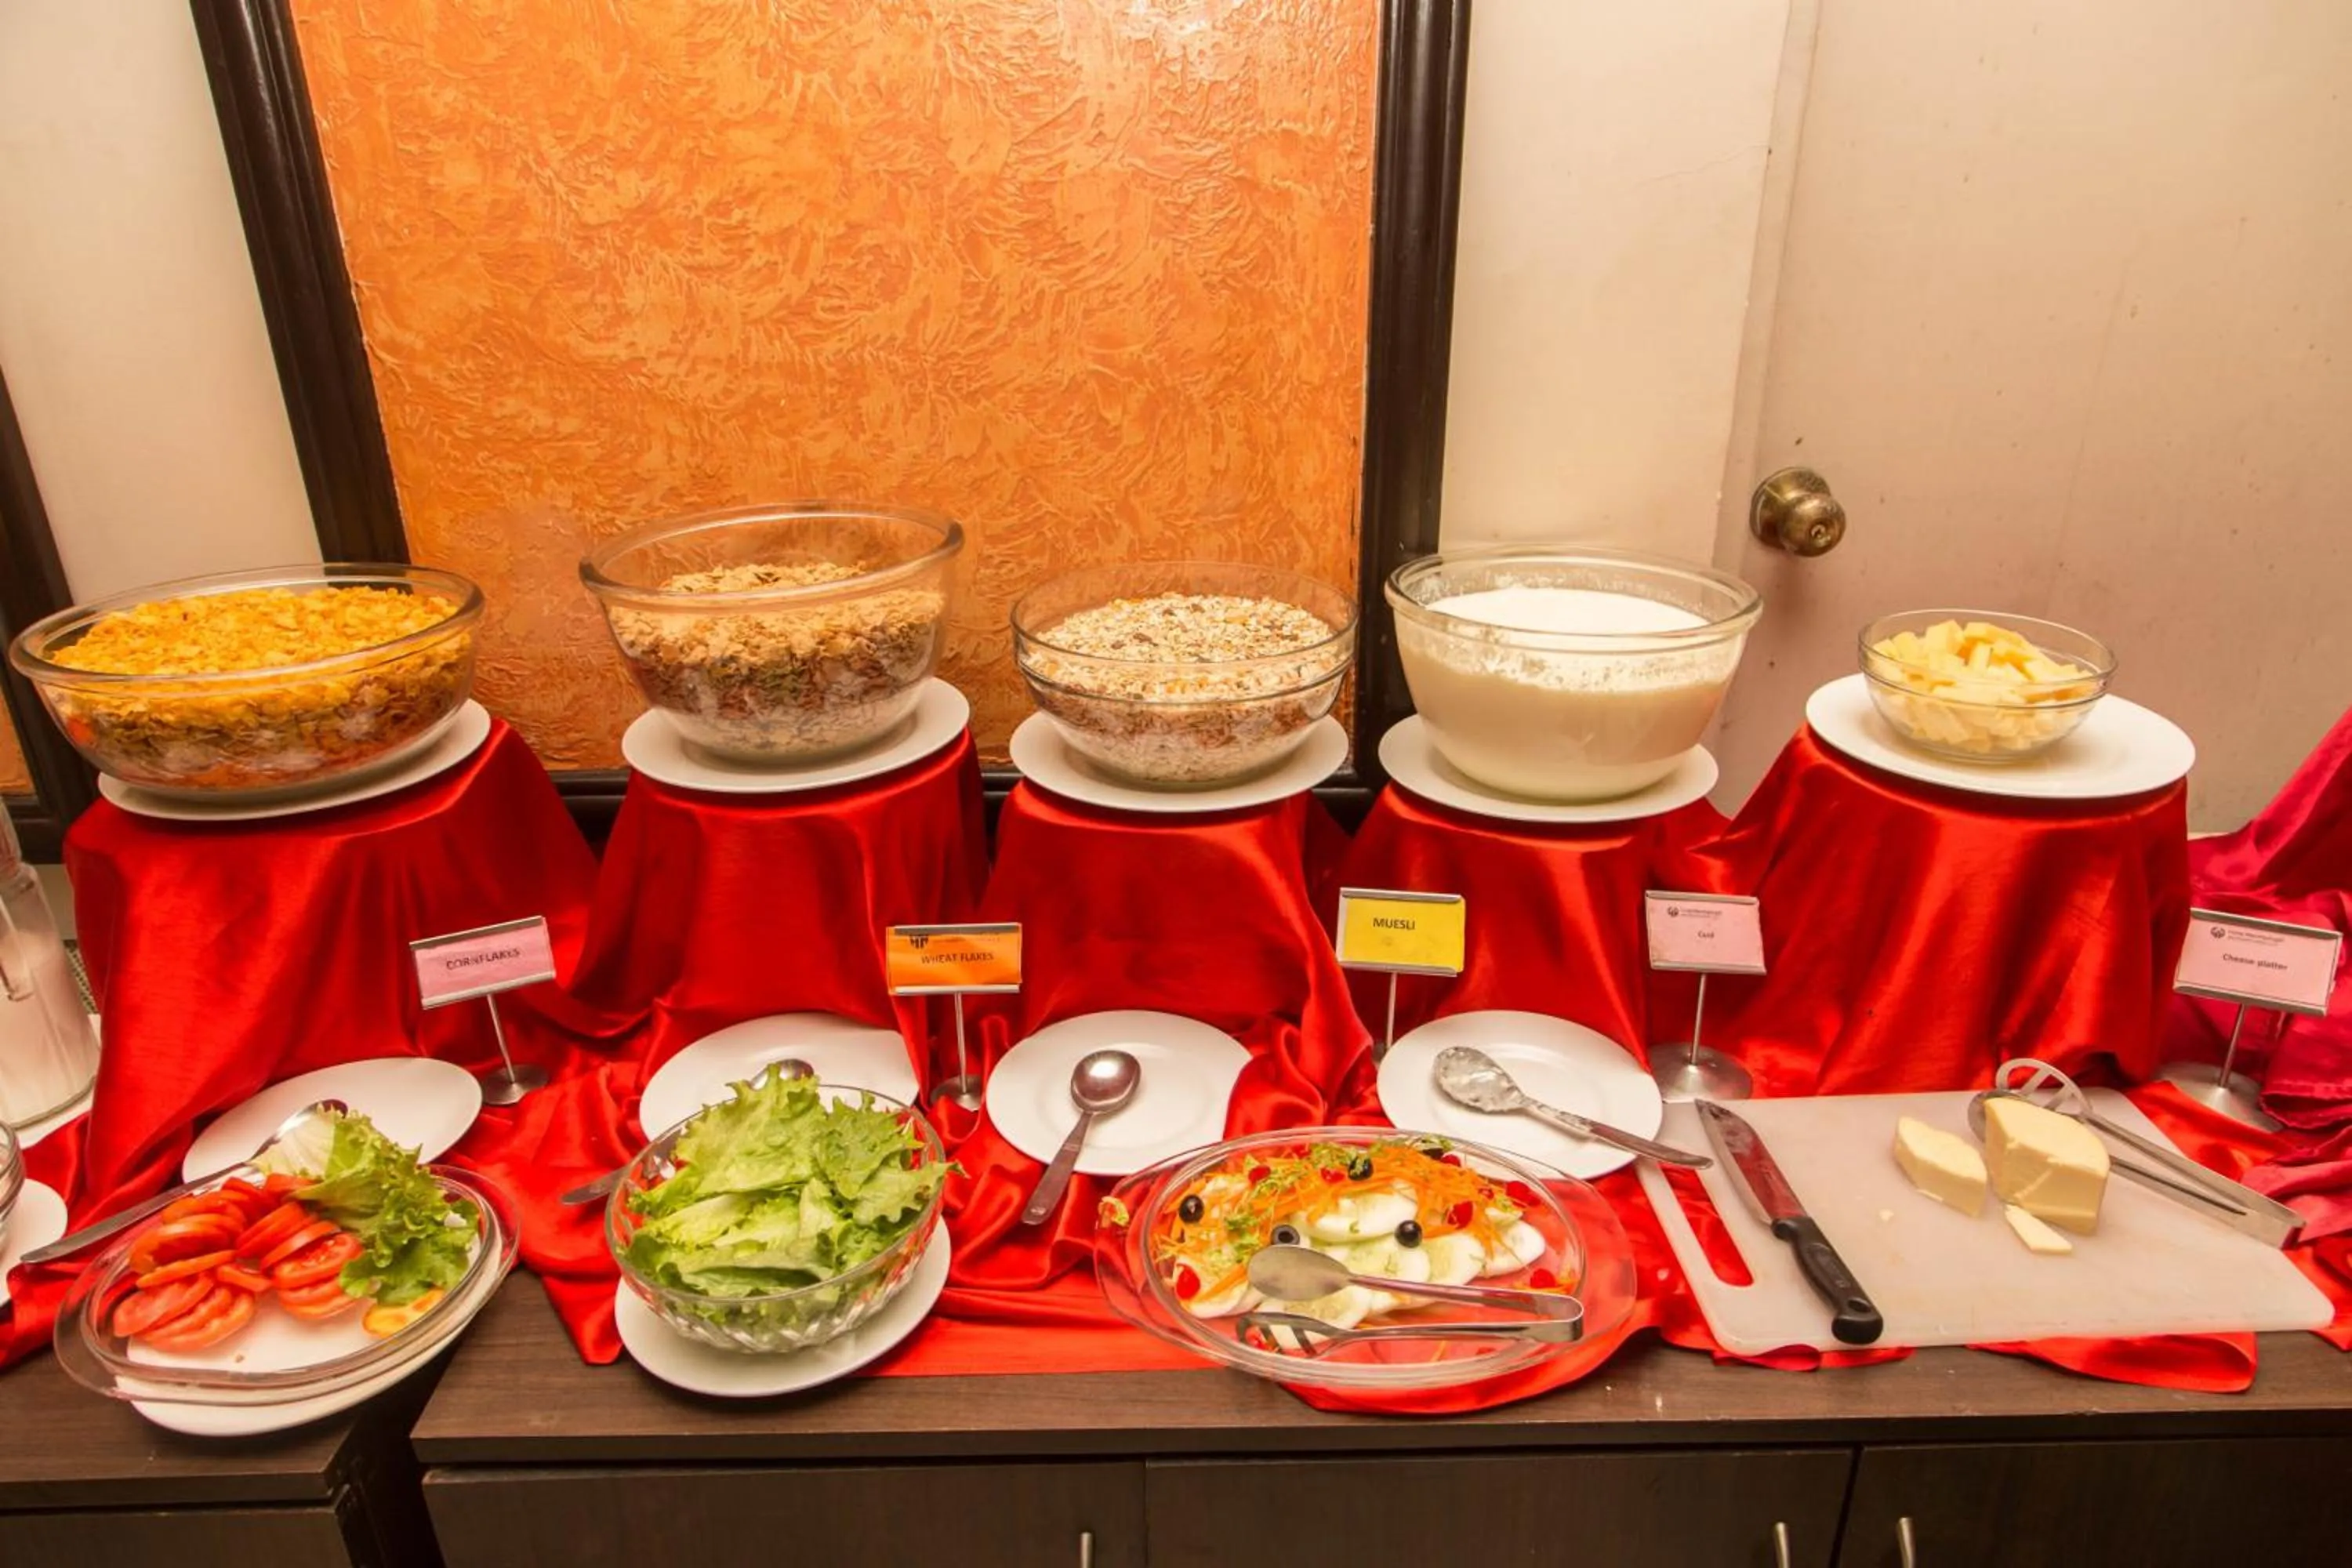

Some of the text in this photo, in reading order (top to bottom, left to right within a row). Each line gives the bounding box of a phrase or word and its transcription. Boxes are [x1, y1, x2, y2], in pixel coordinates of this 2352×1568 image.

[1373, 917, 1416, 931] MUESLI
[445, 947, 521, 971] CORNFLAKES
[921, 953, 994, 964] WHEAT FLAKES
[2222, 953, 2288, 971] Cheese platter
